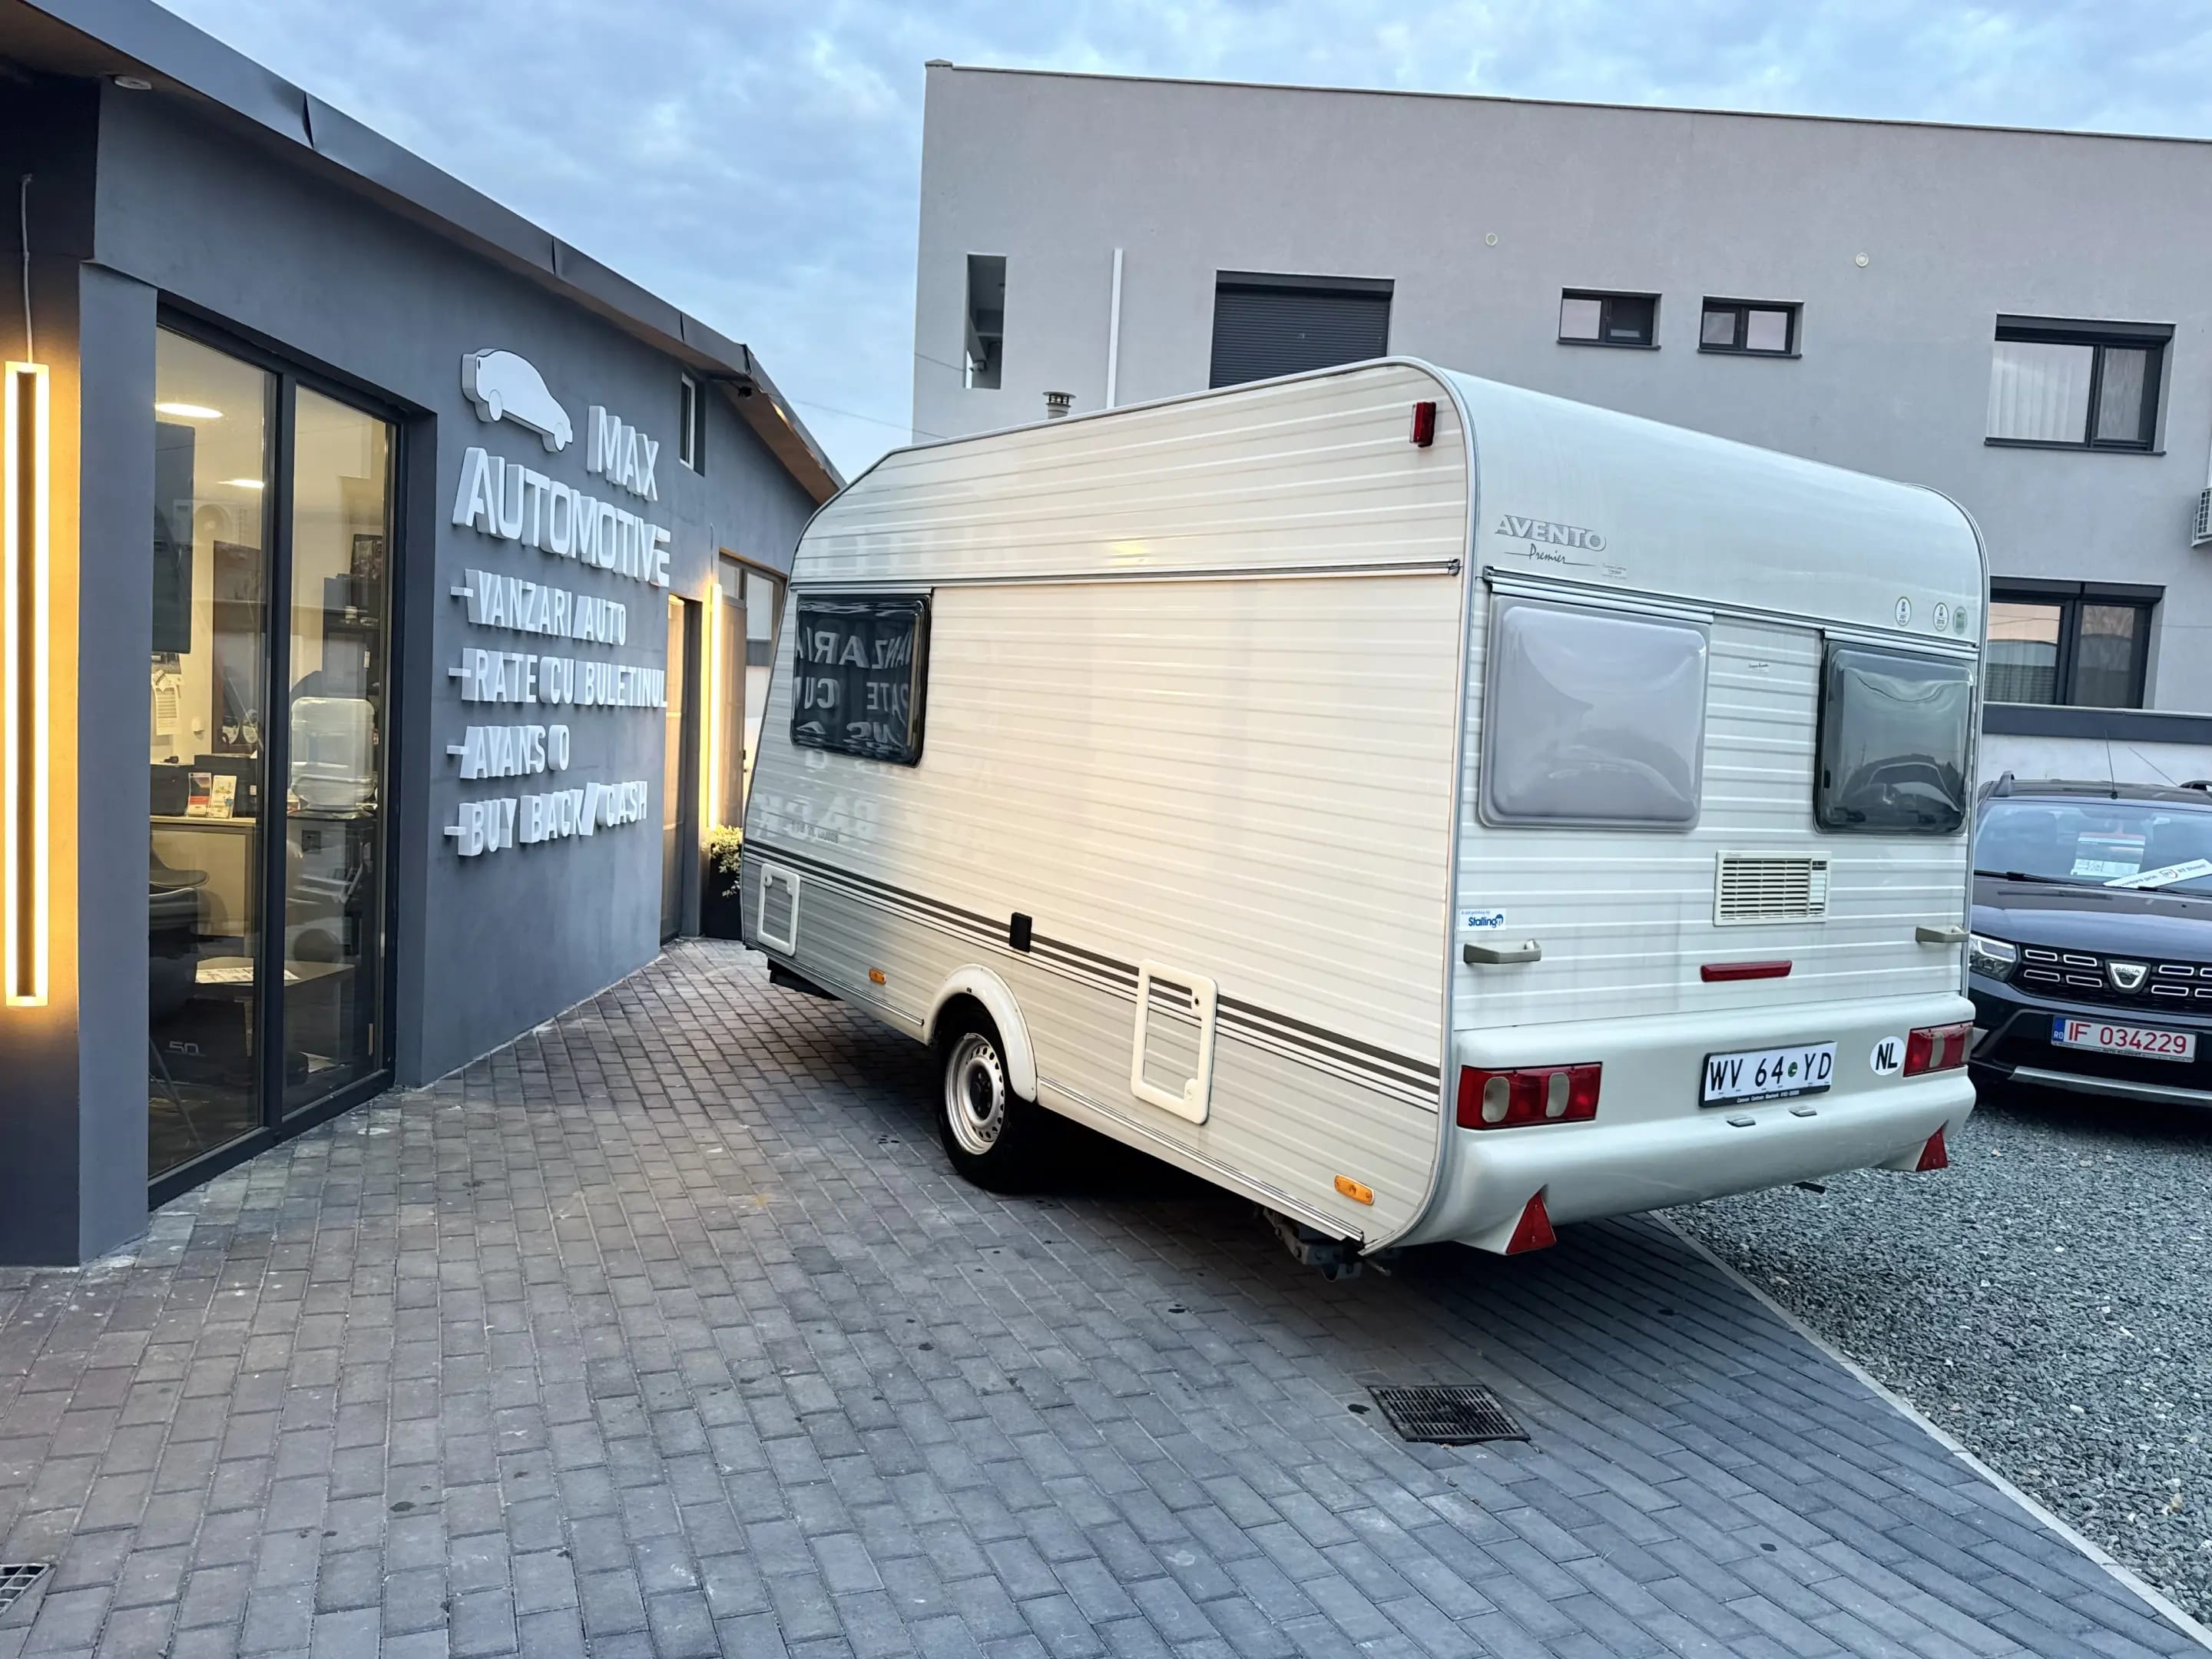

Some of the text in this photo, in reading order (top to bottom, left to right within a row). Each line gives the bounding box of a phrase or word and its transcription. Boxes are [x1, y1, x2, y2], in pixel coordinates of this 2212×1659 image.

[587, 406, 659, 501] MAX
[452, 447, 671, 588] AUTOMOTIVE
[1495, 515, 1607, 551] AVENTO
[1528, 543, 1567, 564] Premier
[573, 595, 626, 645] AUTO
[539, 656, 575, 704] CU
[575, 661, 668, 707] BULETINUL
[1468, 916, 1497, 928] Stalling
[2053, 1031, 2065, 1040] RO
[2068, 1022, 2187, 1055] IF 034229
[1710, 1052, 1832, 1091] WV 64 YD
[1876, 1042, 1898, 1071] NL
